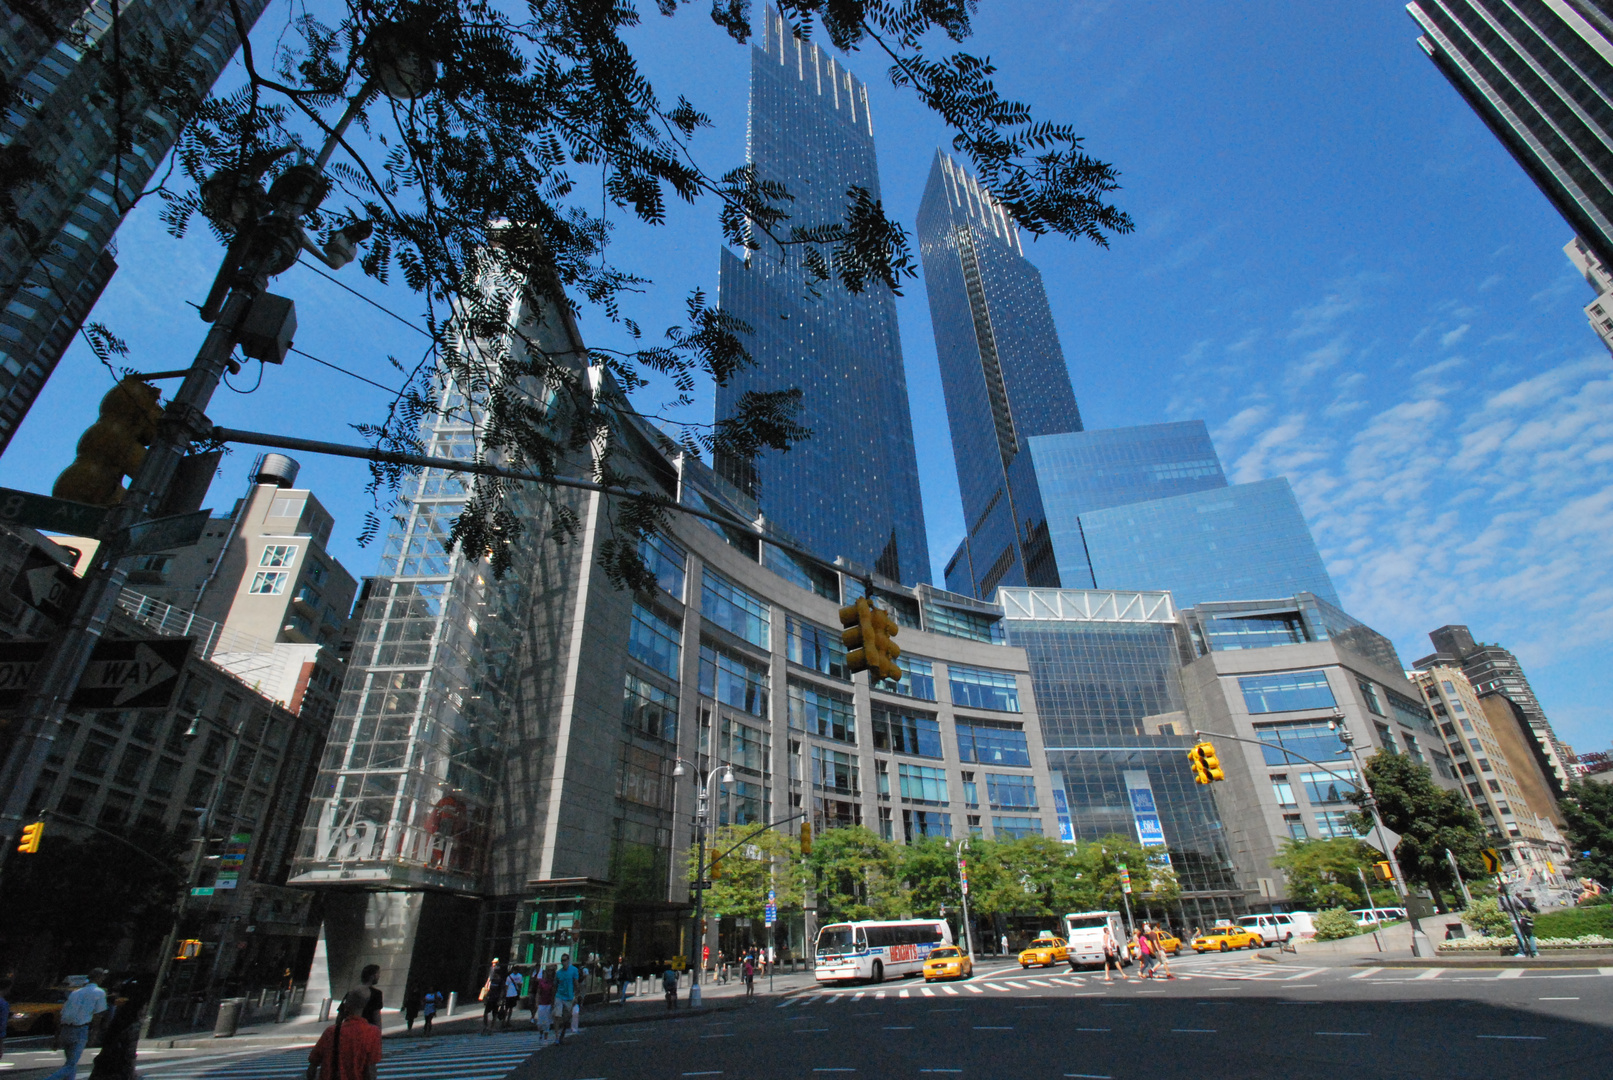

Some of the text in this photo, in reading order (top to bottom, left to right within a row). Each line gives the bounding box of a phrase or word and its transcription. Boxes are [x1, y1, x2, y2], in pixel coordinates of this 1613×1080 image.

[1, 495, 26, 519] 8
[0, 662, 163, 687] ON WAY
[890, 944, 918, 962] HEIGHTS
